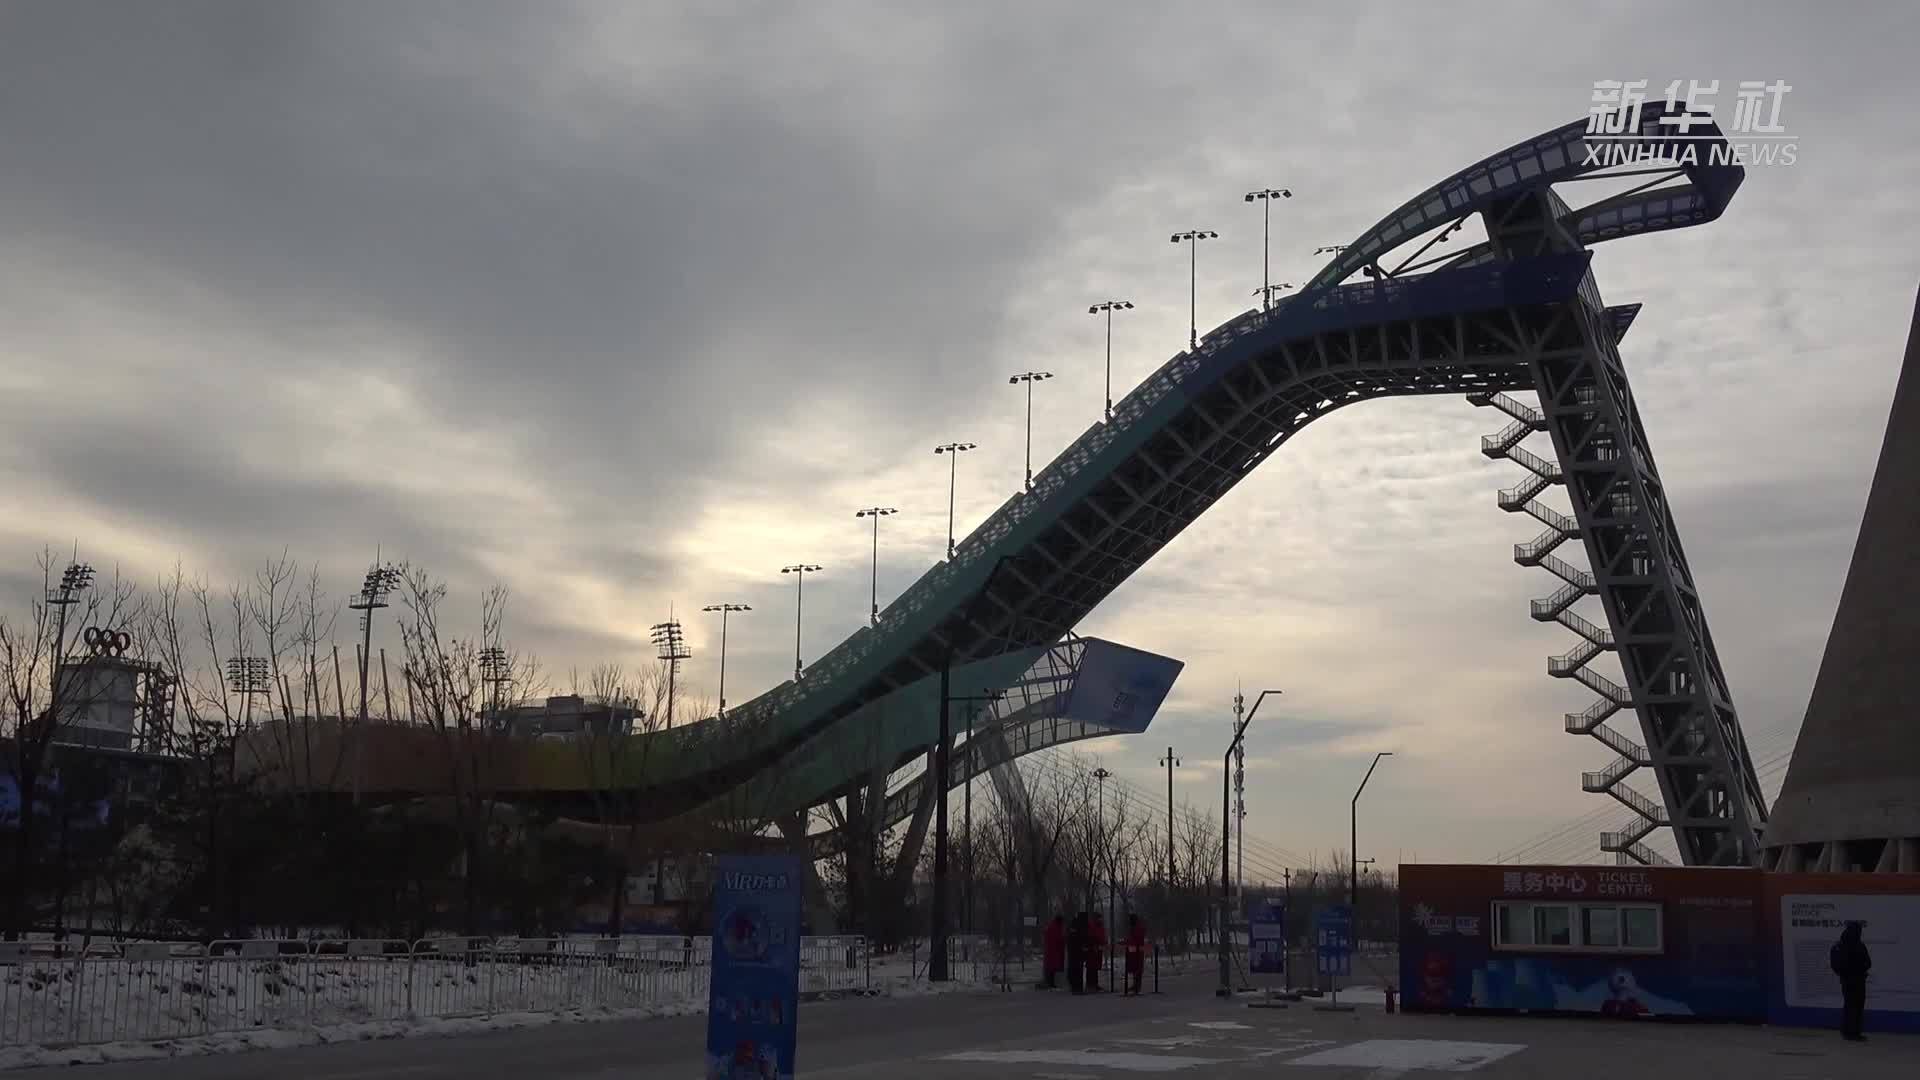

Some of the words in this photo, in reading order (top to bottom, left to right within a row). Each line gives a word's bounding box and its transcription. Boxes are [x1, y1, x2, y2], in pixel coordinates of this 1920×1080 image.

[1503, 871, 1587, 893] 票务中心
[1597, 871, 1648, 882] TICKET
[1597, 883, 1654, 896] CENTER
